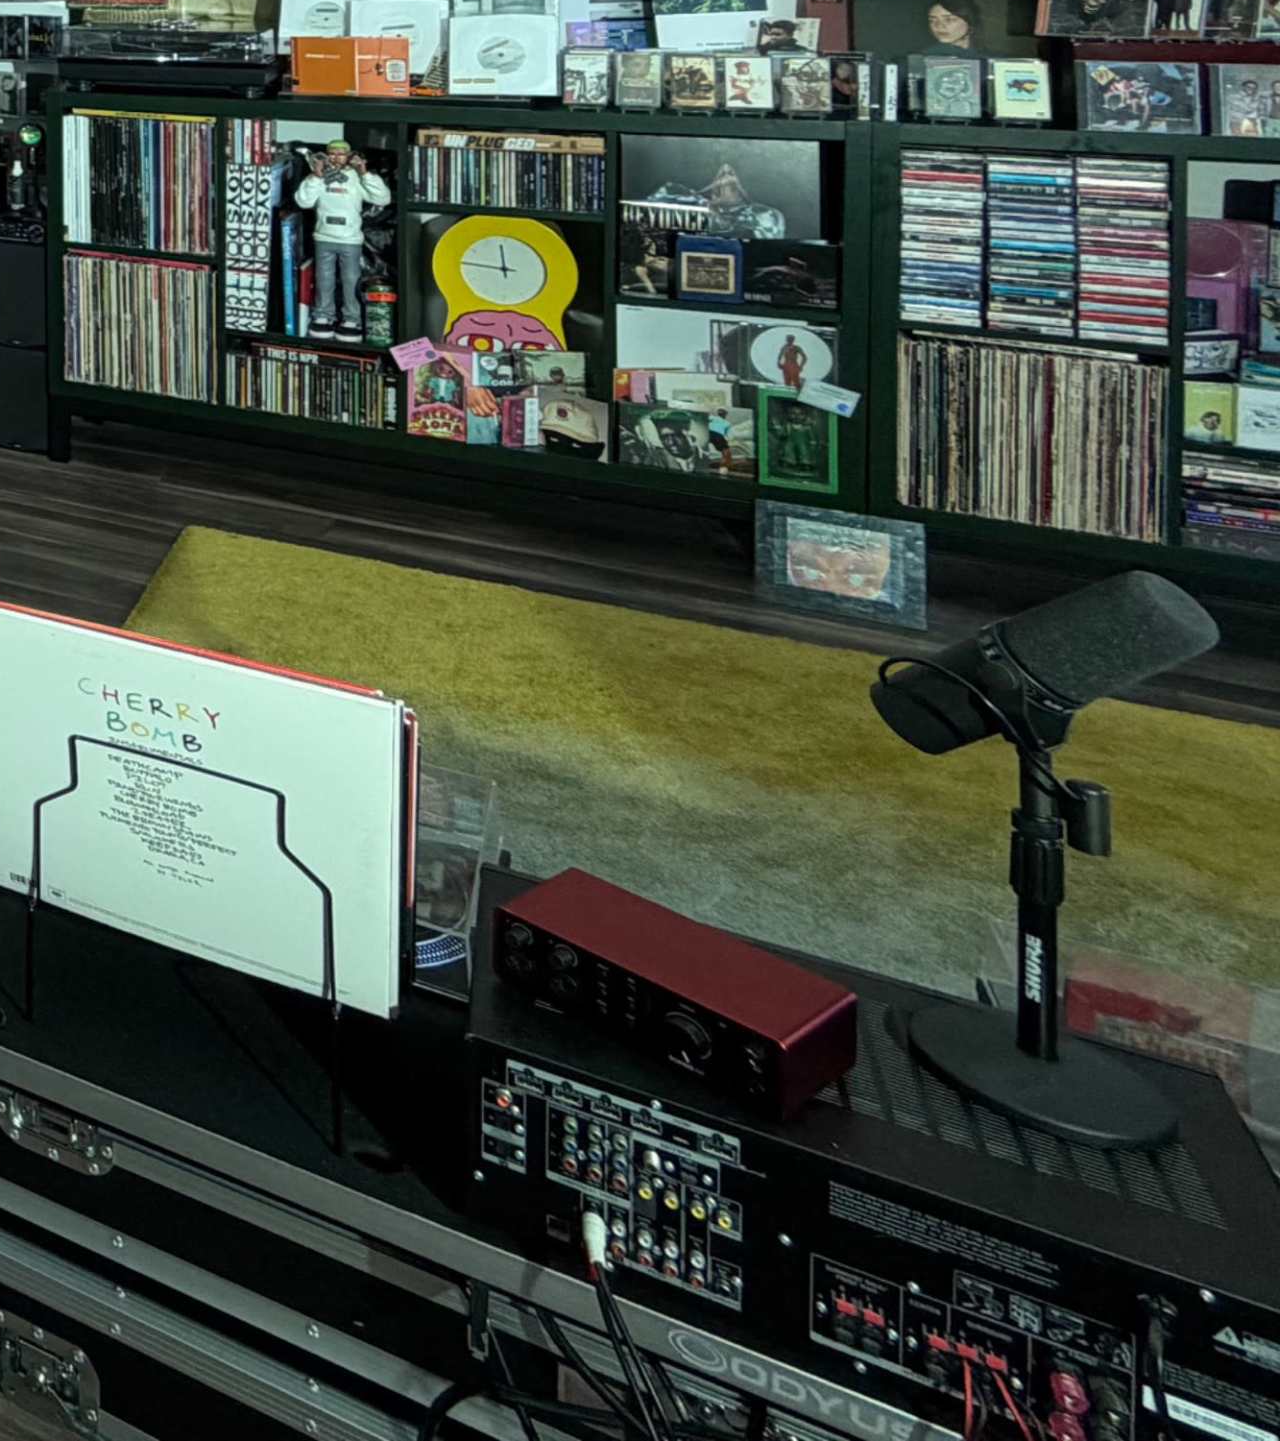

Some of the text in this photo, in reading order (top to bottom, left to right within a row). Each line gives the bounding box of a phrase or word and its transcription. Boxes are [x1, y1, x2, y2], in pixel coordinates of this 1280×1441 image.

[77, 676, 221, 731] CHERRY
[105, 710, 203, 754] BOMB
[1024, 933, 1043, 1004] SHURE
